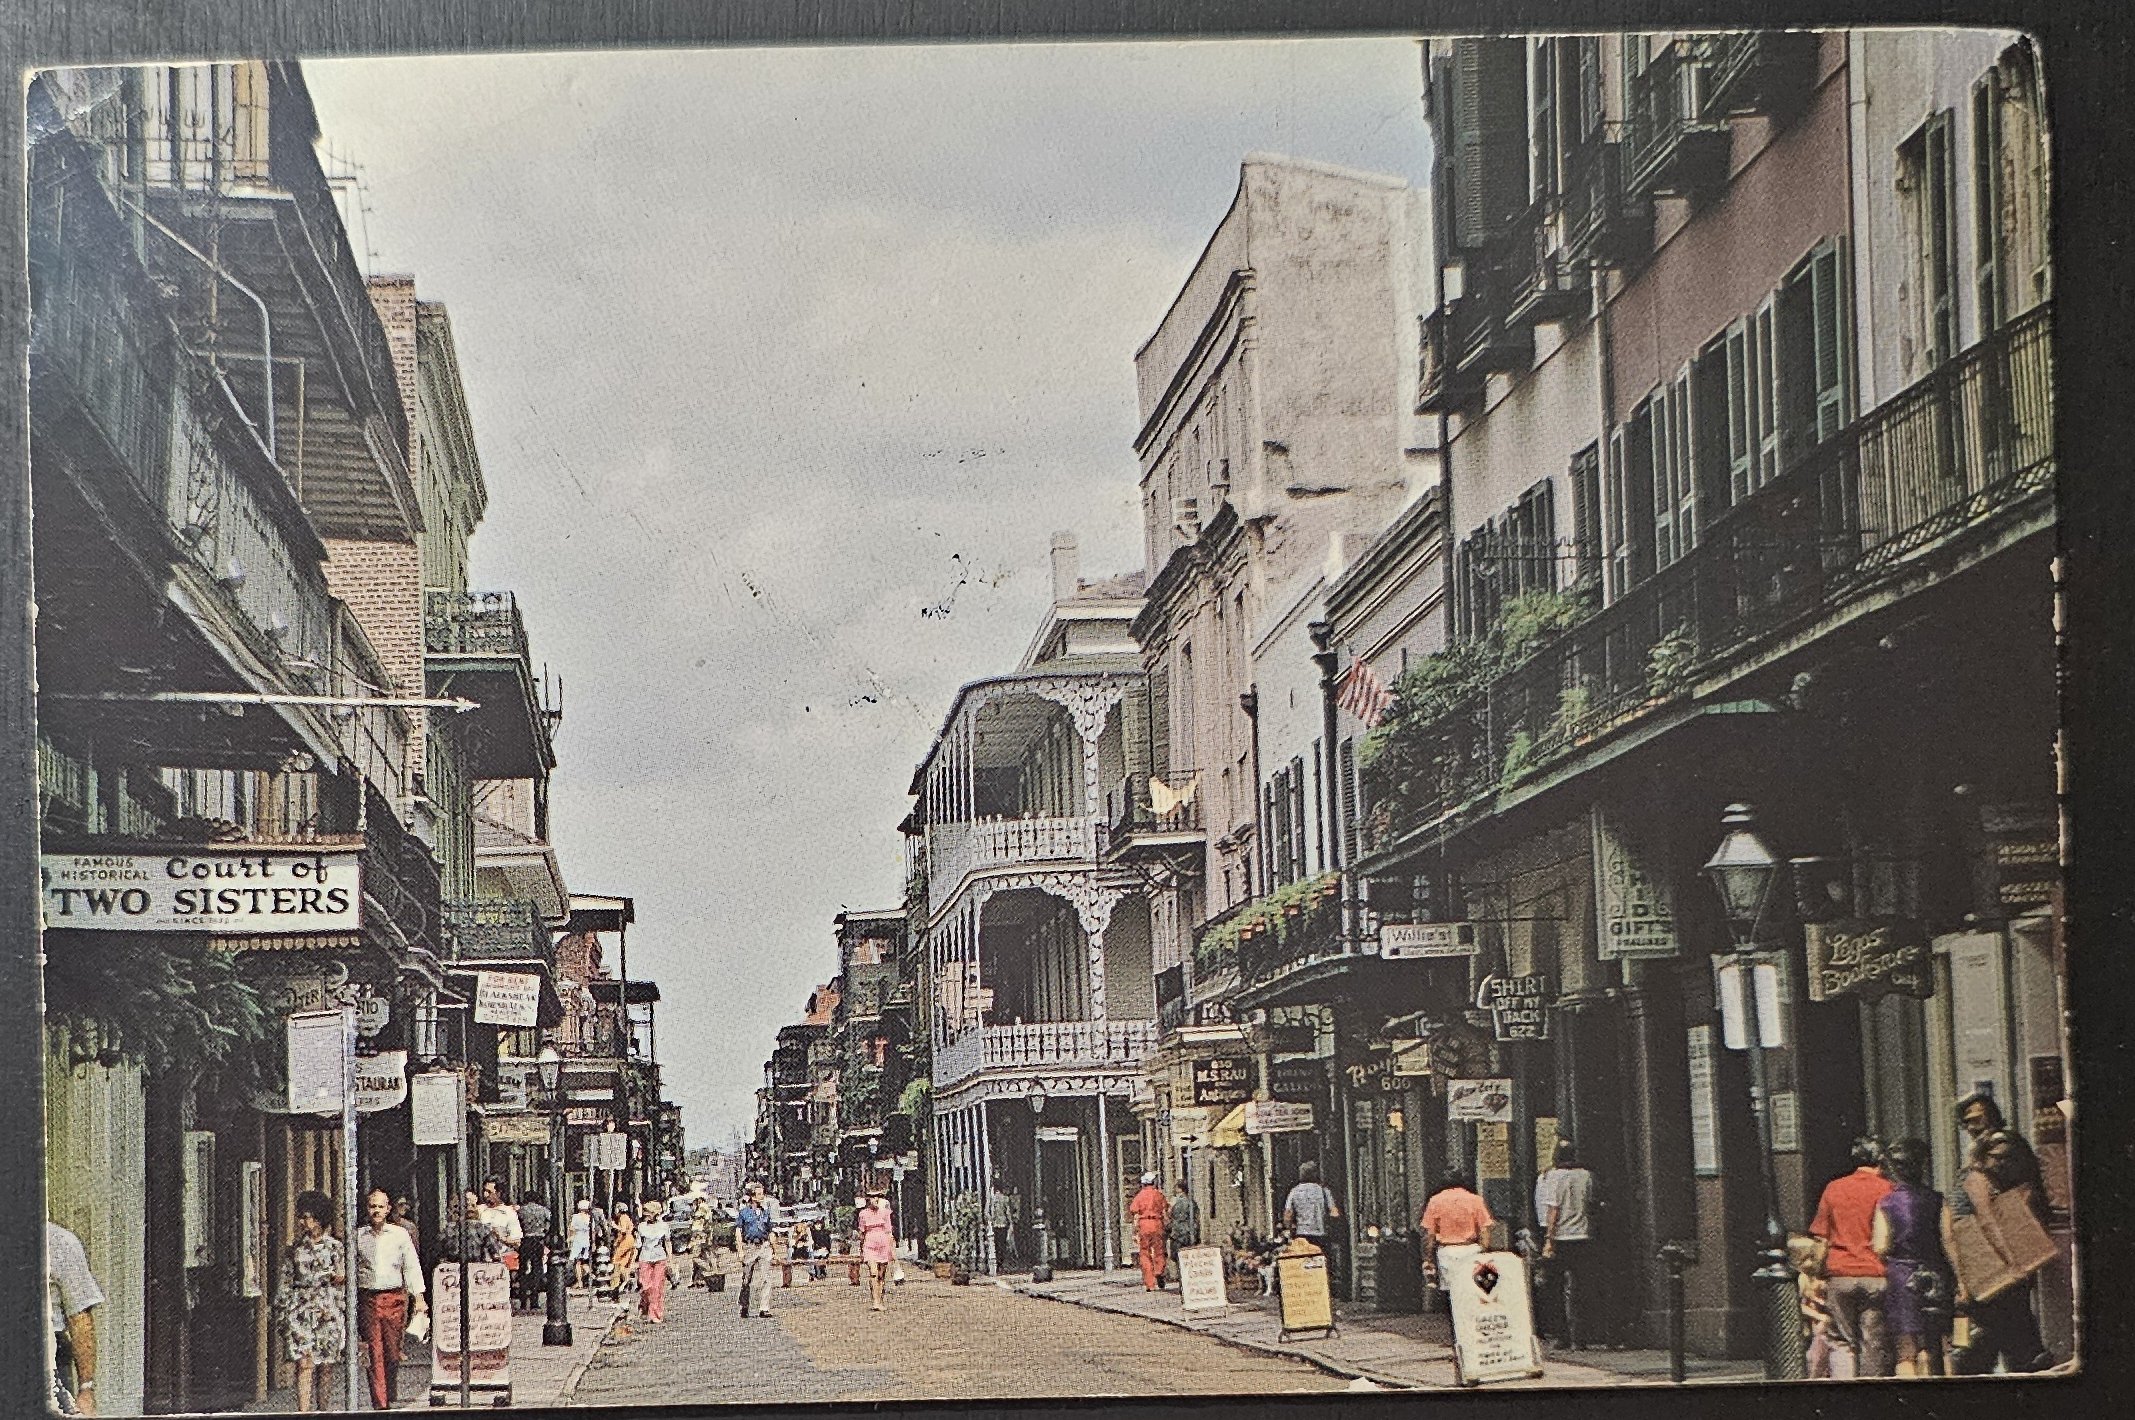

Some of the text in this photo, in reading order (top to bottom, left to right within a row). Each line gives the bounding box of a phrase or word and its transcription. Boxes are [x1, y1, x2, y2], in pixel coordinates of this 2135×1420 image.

[74, 857, 134, 868] FAMOUS
[167, 855, 328, 884] Court of
[61, 869, 150, 881] HISTORICAL
[50, 887, 350, 916] TWO SISTERS
[1491, 976, 1545, 997] SHIRT
